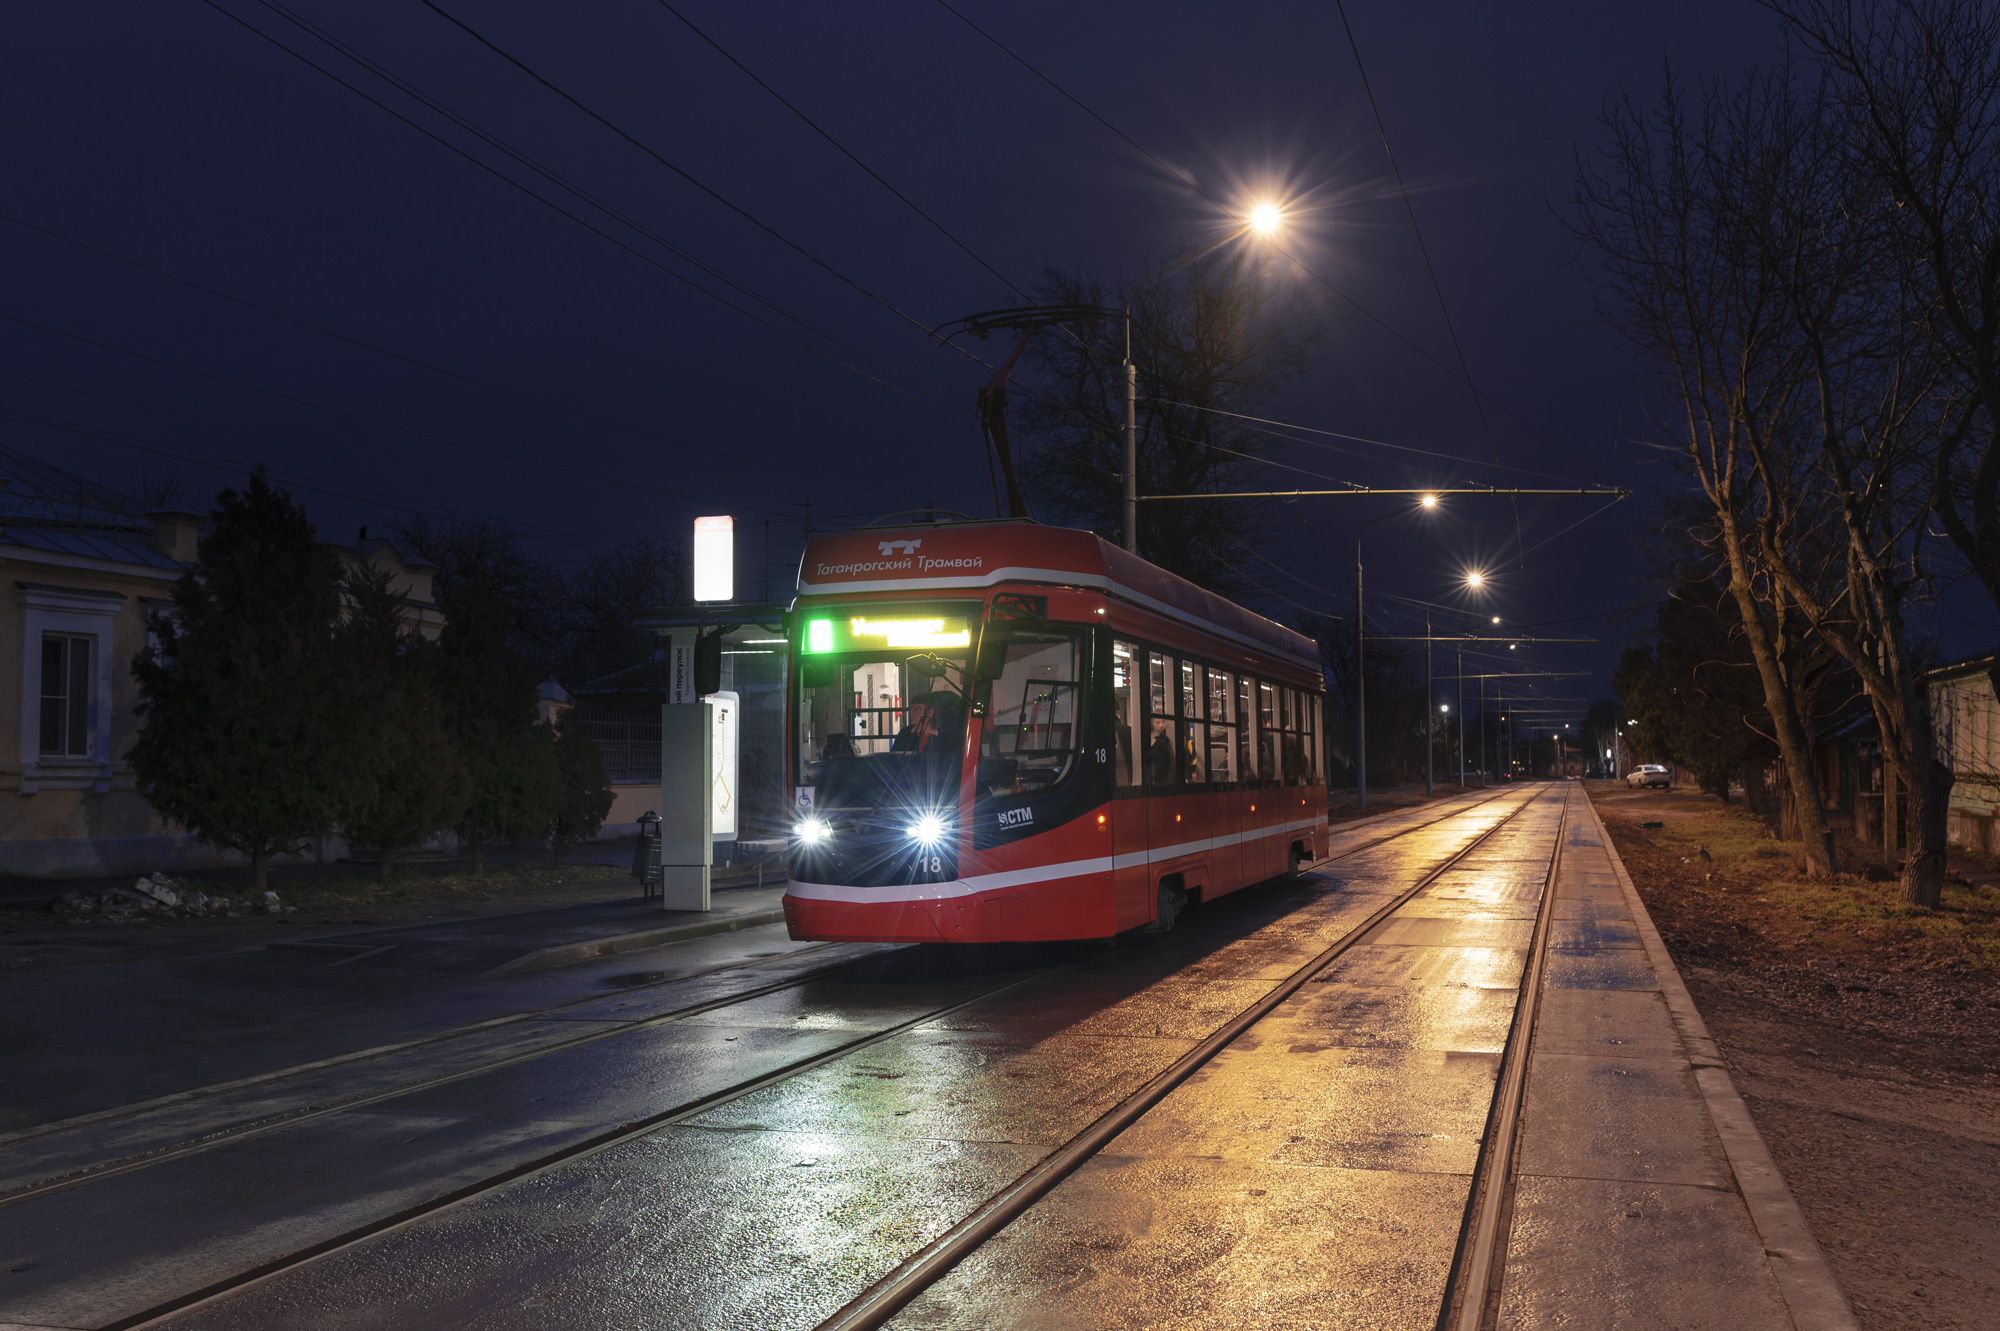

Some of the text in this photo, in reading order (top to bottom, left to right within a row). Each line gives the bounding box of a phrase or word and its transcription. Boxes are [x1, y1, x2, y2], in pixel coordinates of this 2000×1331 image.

[816, 555, 983, 576] Таганрогский Трамвай
[676, 647, 684, 689] переулок
[1095, 748, 1106, 763] 18
[920, 856, 942, 873] 18
